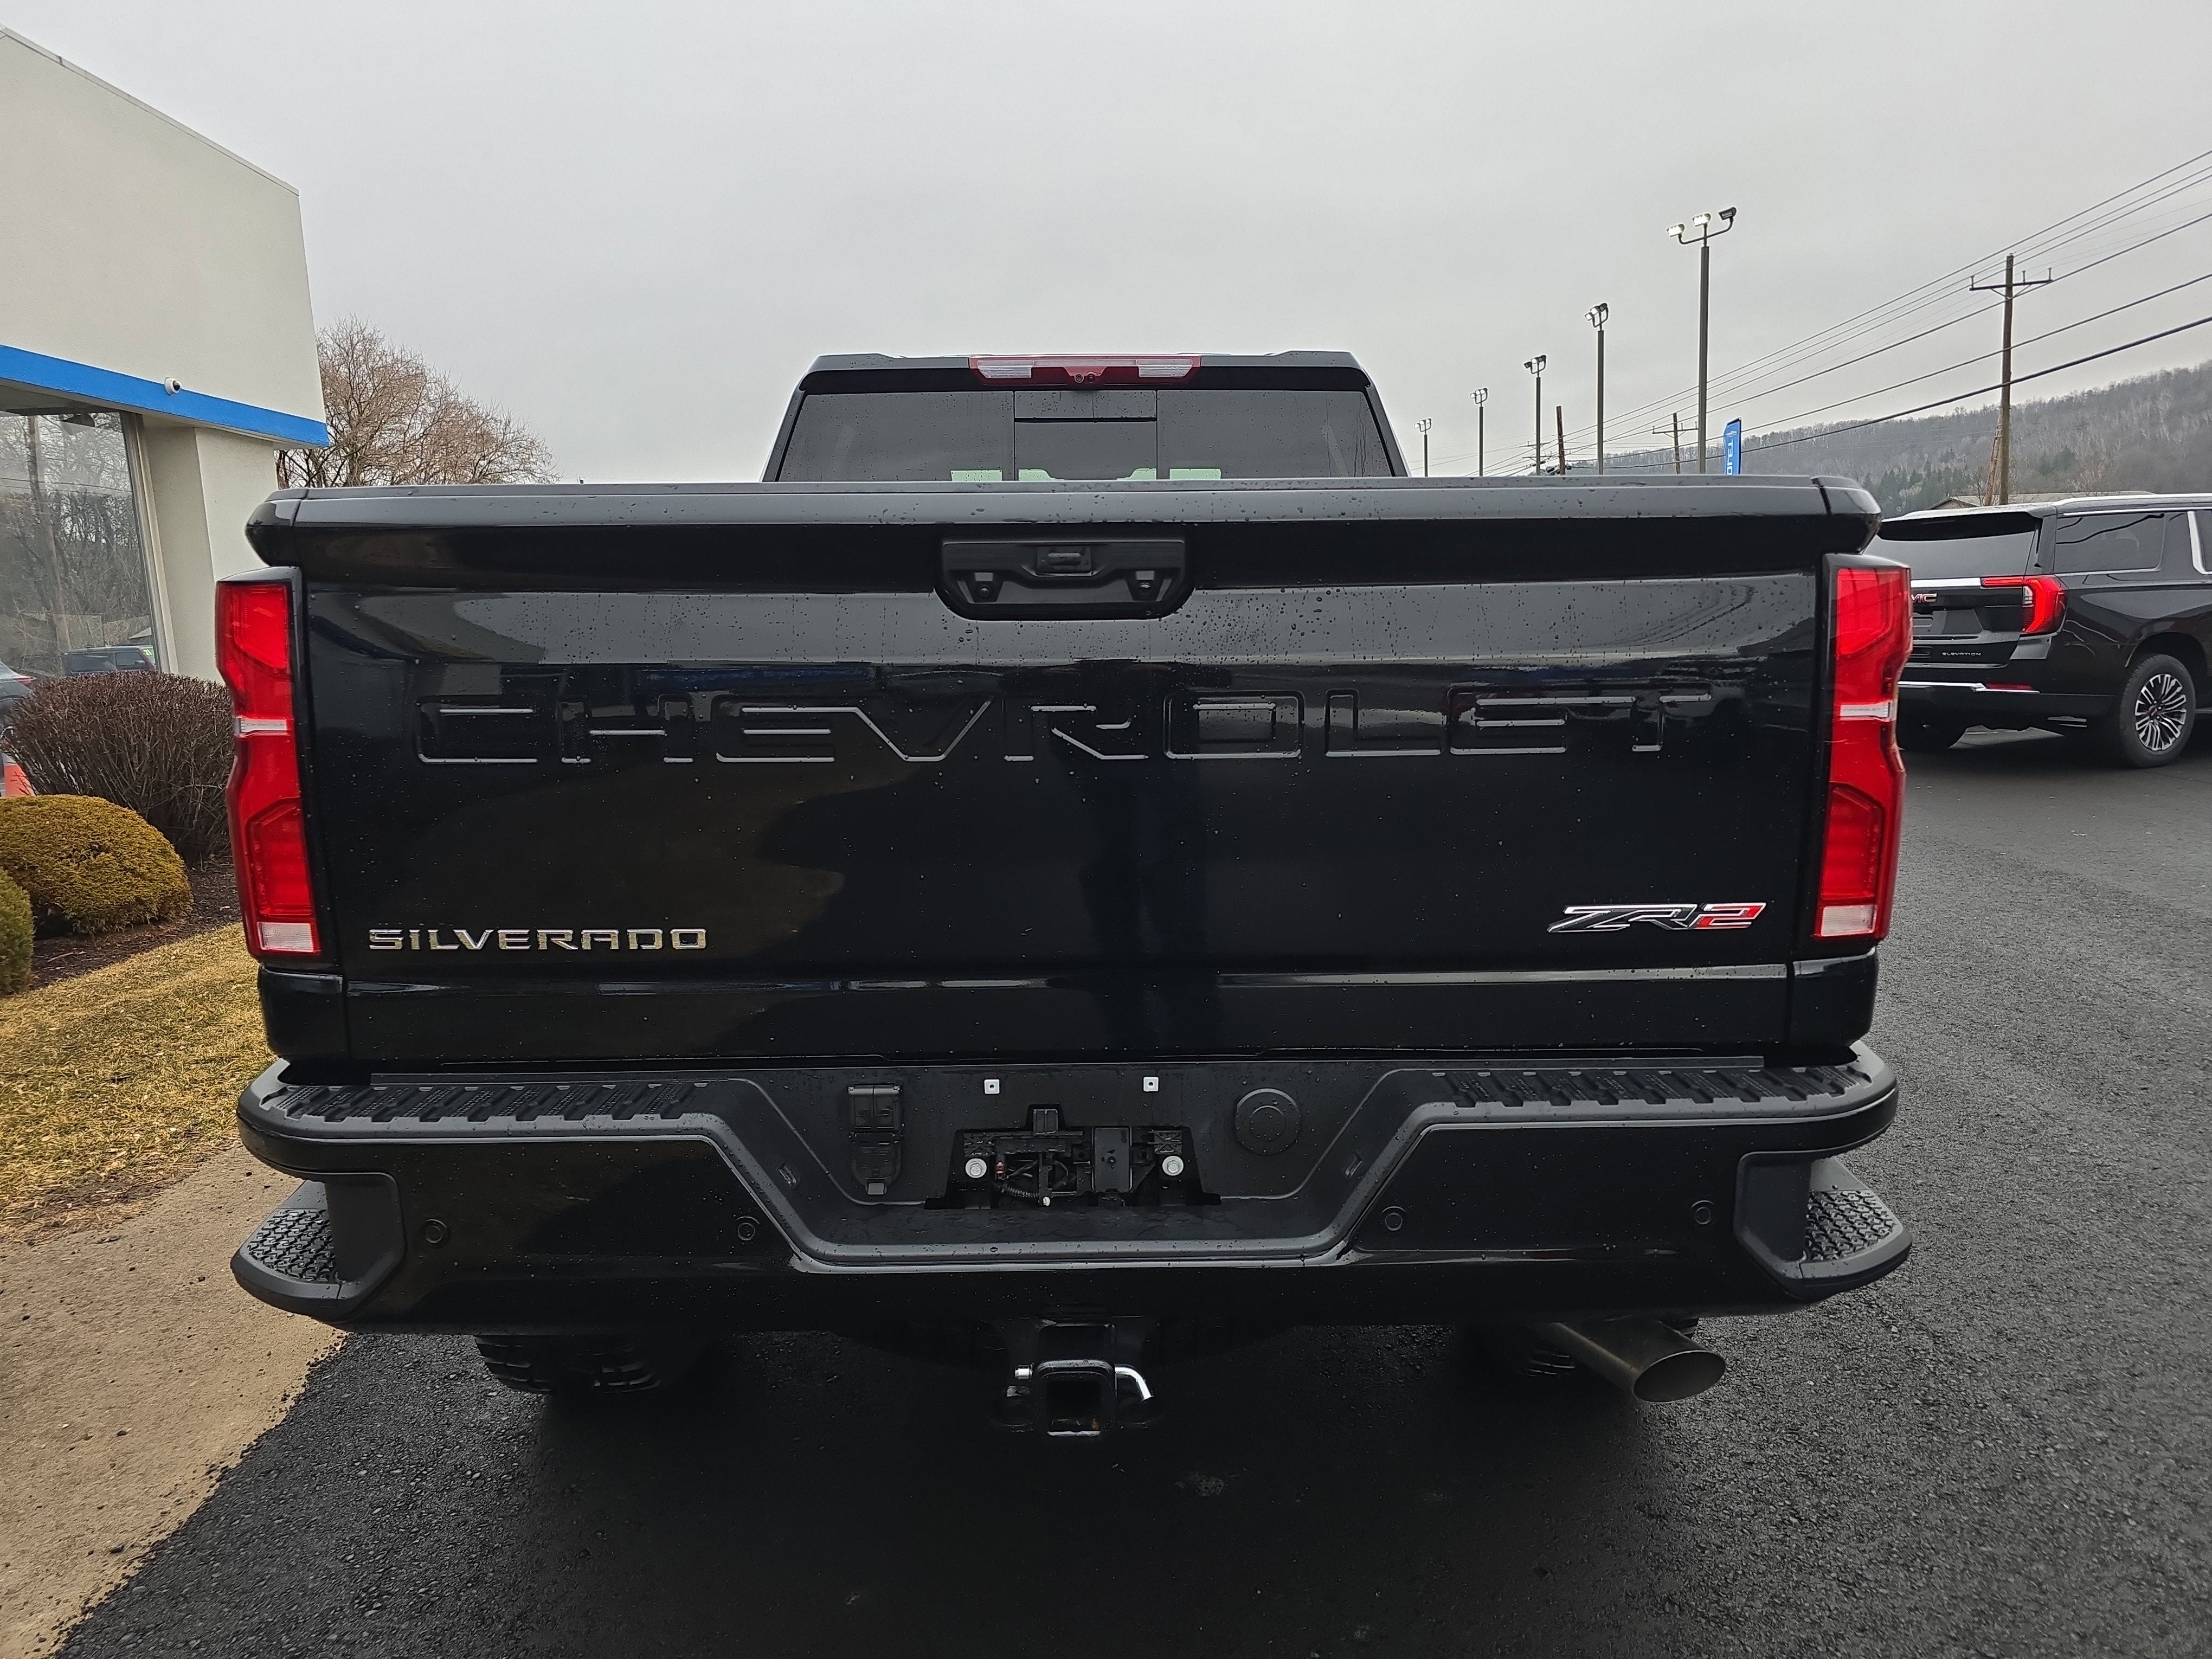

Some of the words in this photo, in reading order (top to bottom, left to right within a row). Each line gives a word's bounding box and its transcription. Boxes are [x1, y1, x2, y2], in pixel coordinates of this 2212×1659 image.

[414, 684, 1712, 763] CHEVROLET
[1546, 902, 1767, 933] ZR2
[368, 928, 708, 951] SILVERADO
